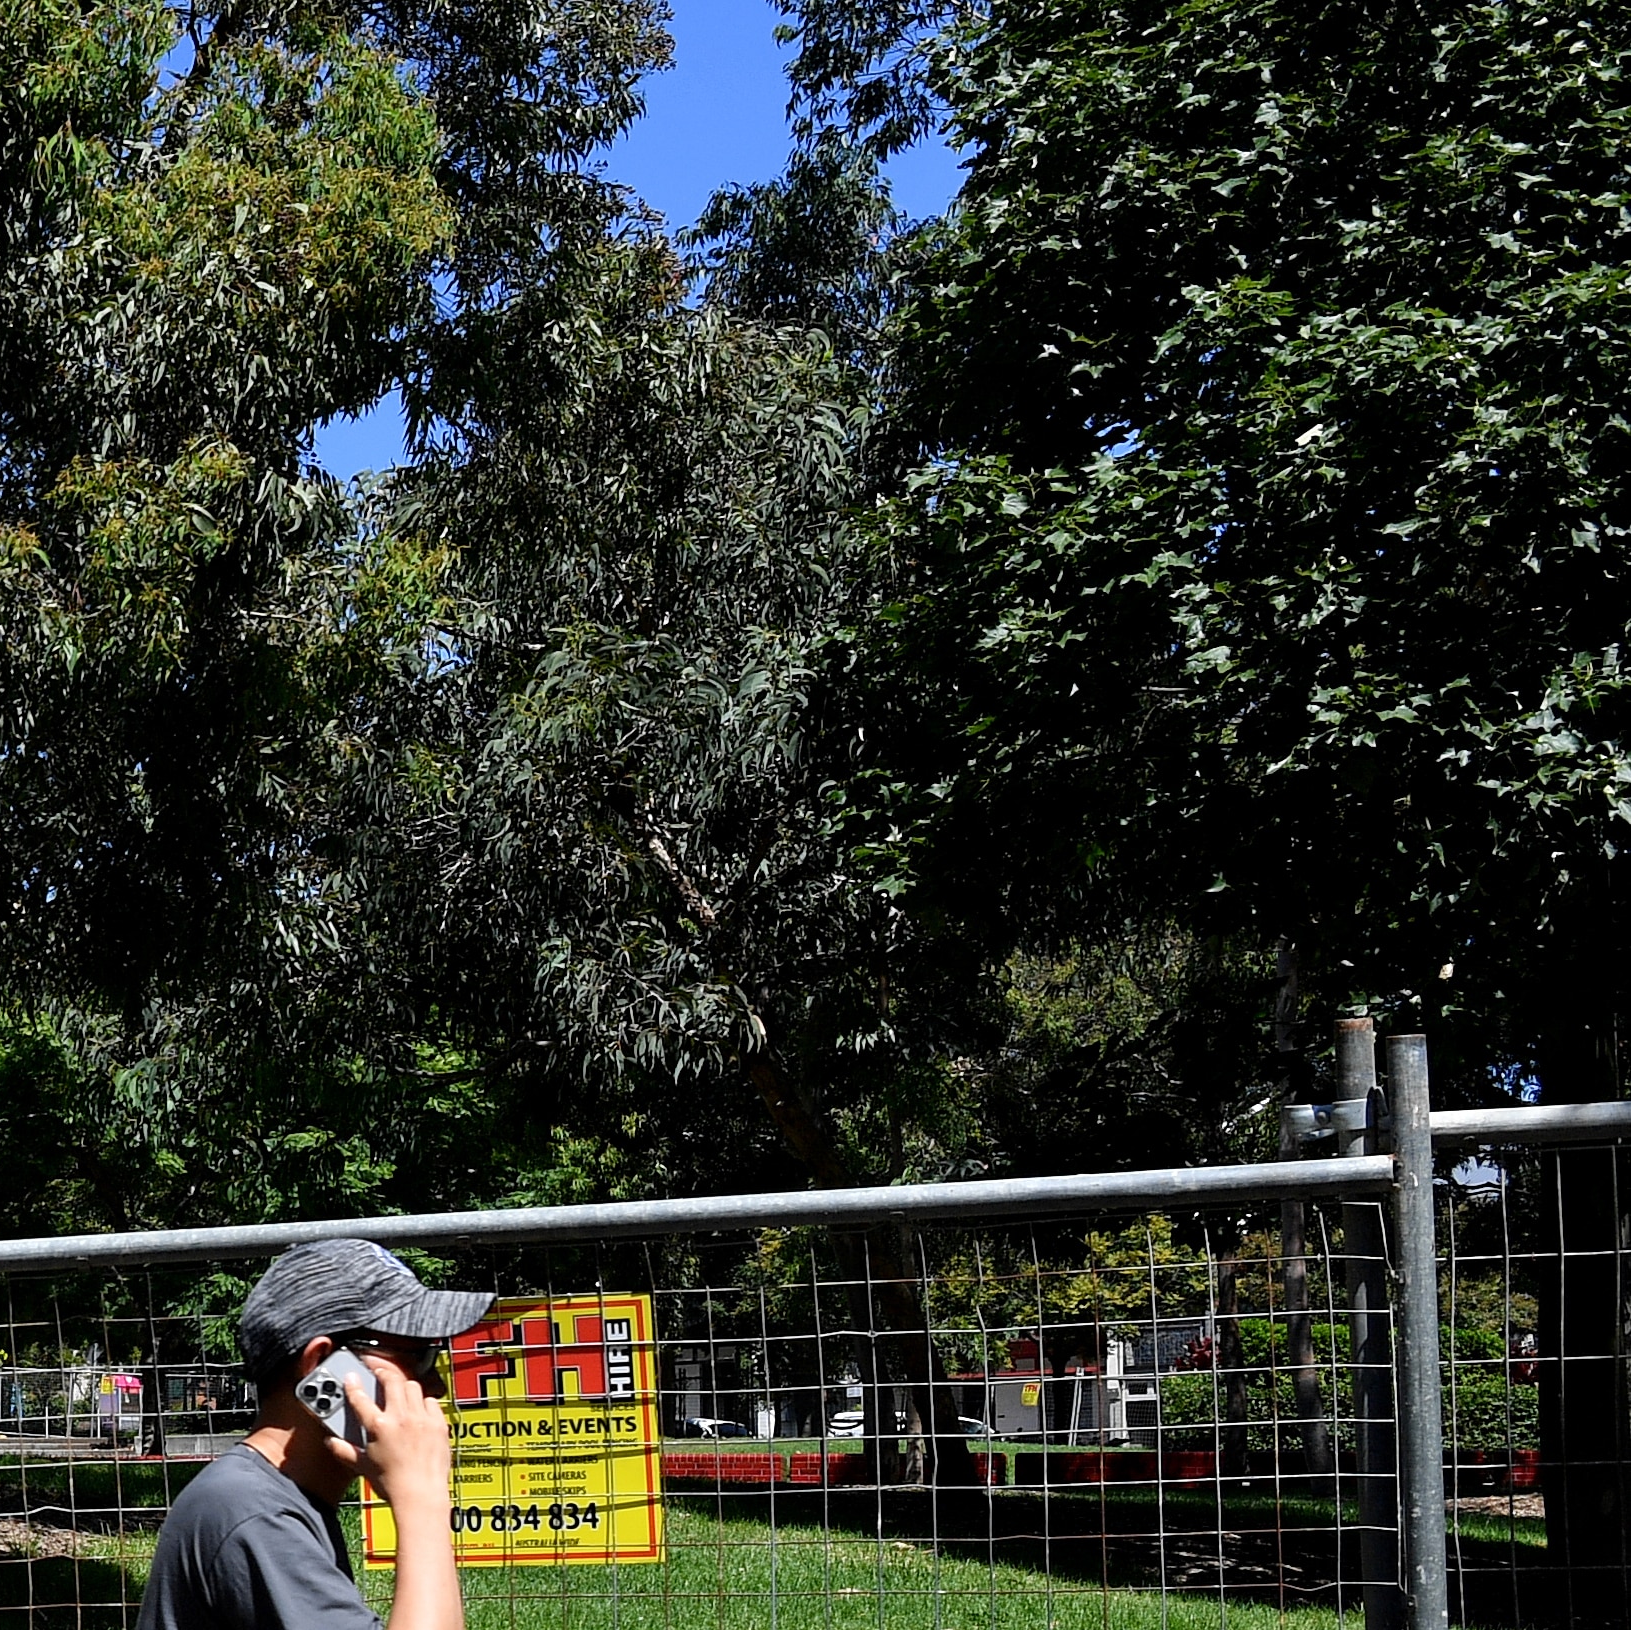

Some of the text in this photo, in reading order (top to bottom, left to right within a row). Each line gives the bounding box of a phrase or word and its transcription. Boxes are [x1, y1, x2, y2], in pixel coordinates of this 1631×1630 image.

[450, 1315, 608, 1405] FH
[606, 1321, 632, 1399] HIRE
[538, 1420, 553, 1436] &
[558, 1416, 637, 1435] EVENTS
[528, 1471, 587, 1482] SITE CAMERAS
[562, 1486, 587, 1495] SKIPS
[450, 1502, 599, 1533] 00 834 834
